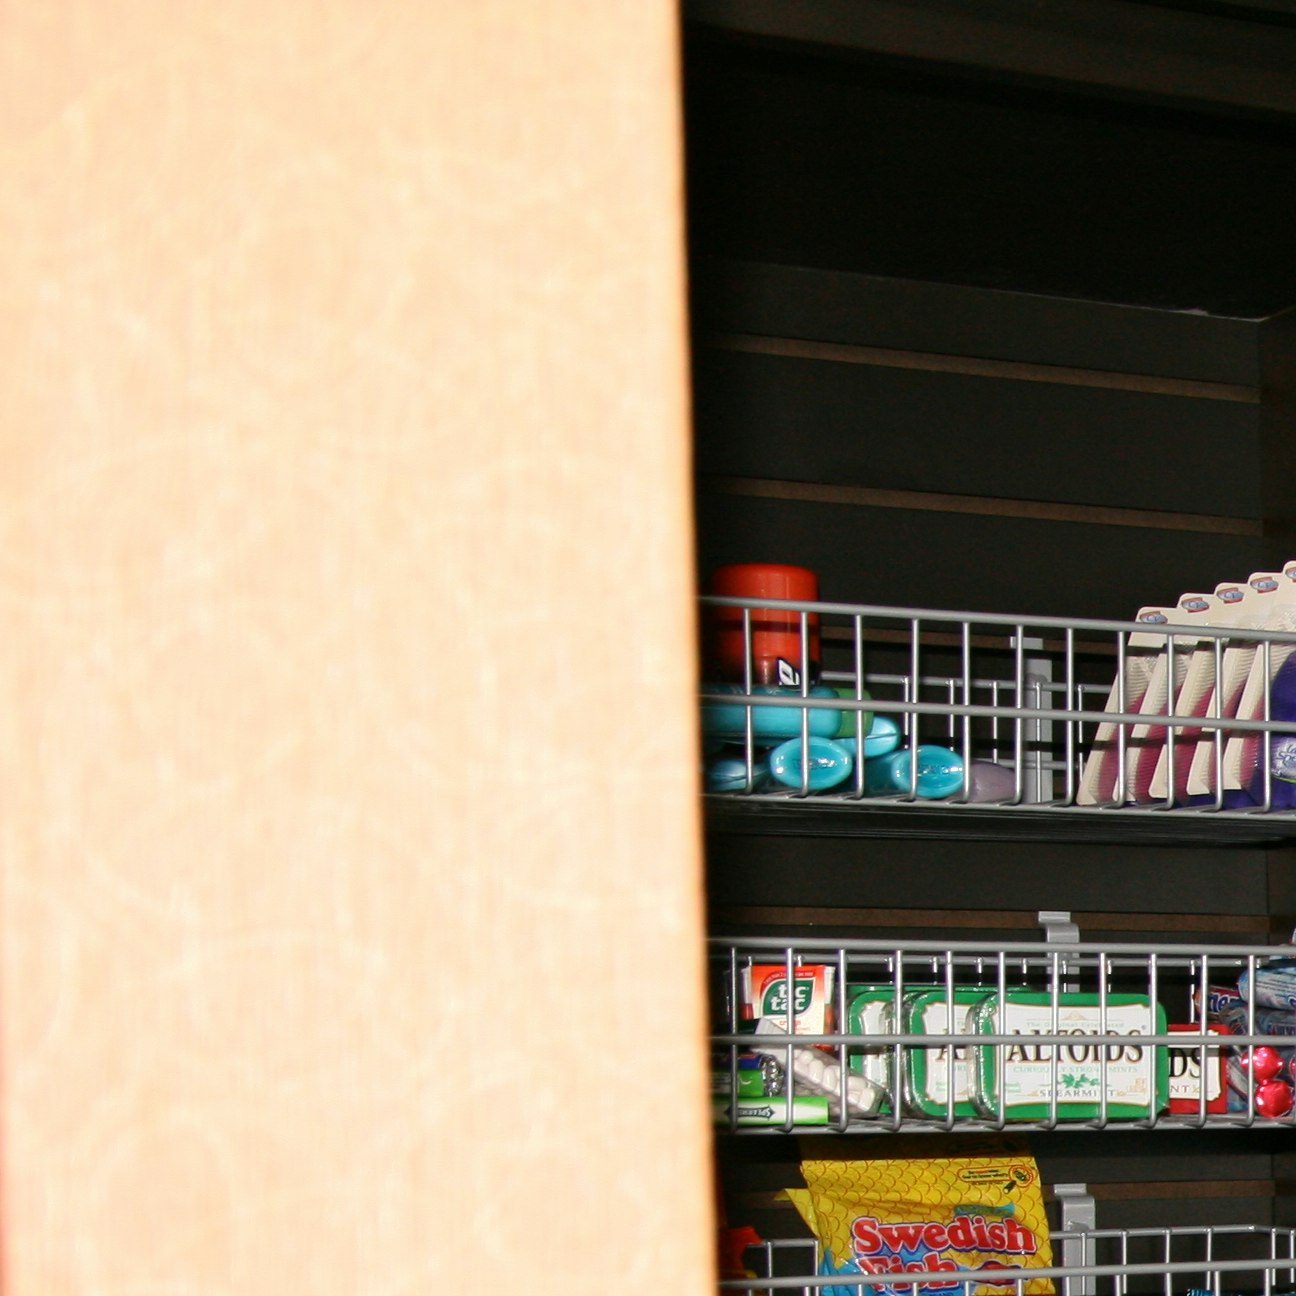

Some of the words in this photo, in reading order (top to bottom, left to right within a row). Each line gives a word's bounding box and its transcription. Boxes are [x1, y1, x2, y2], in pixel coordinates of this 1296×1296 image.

[1006, 1027, 1143, 1063] ALTOIDS
[1039, 1088, 1115, 1098] SPEARMIT
[852, 1217, 1037, 1254] Swedish
[857, 1252, 960, 1294] Fish
